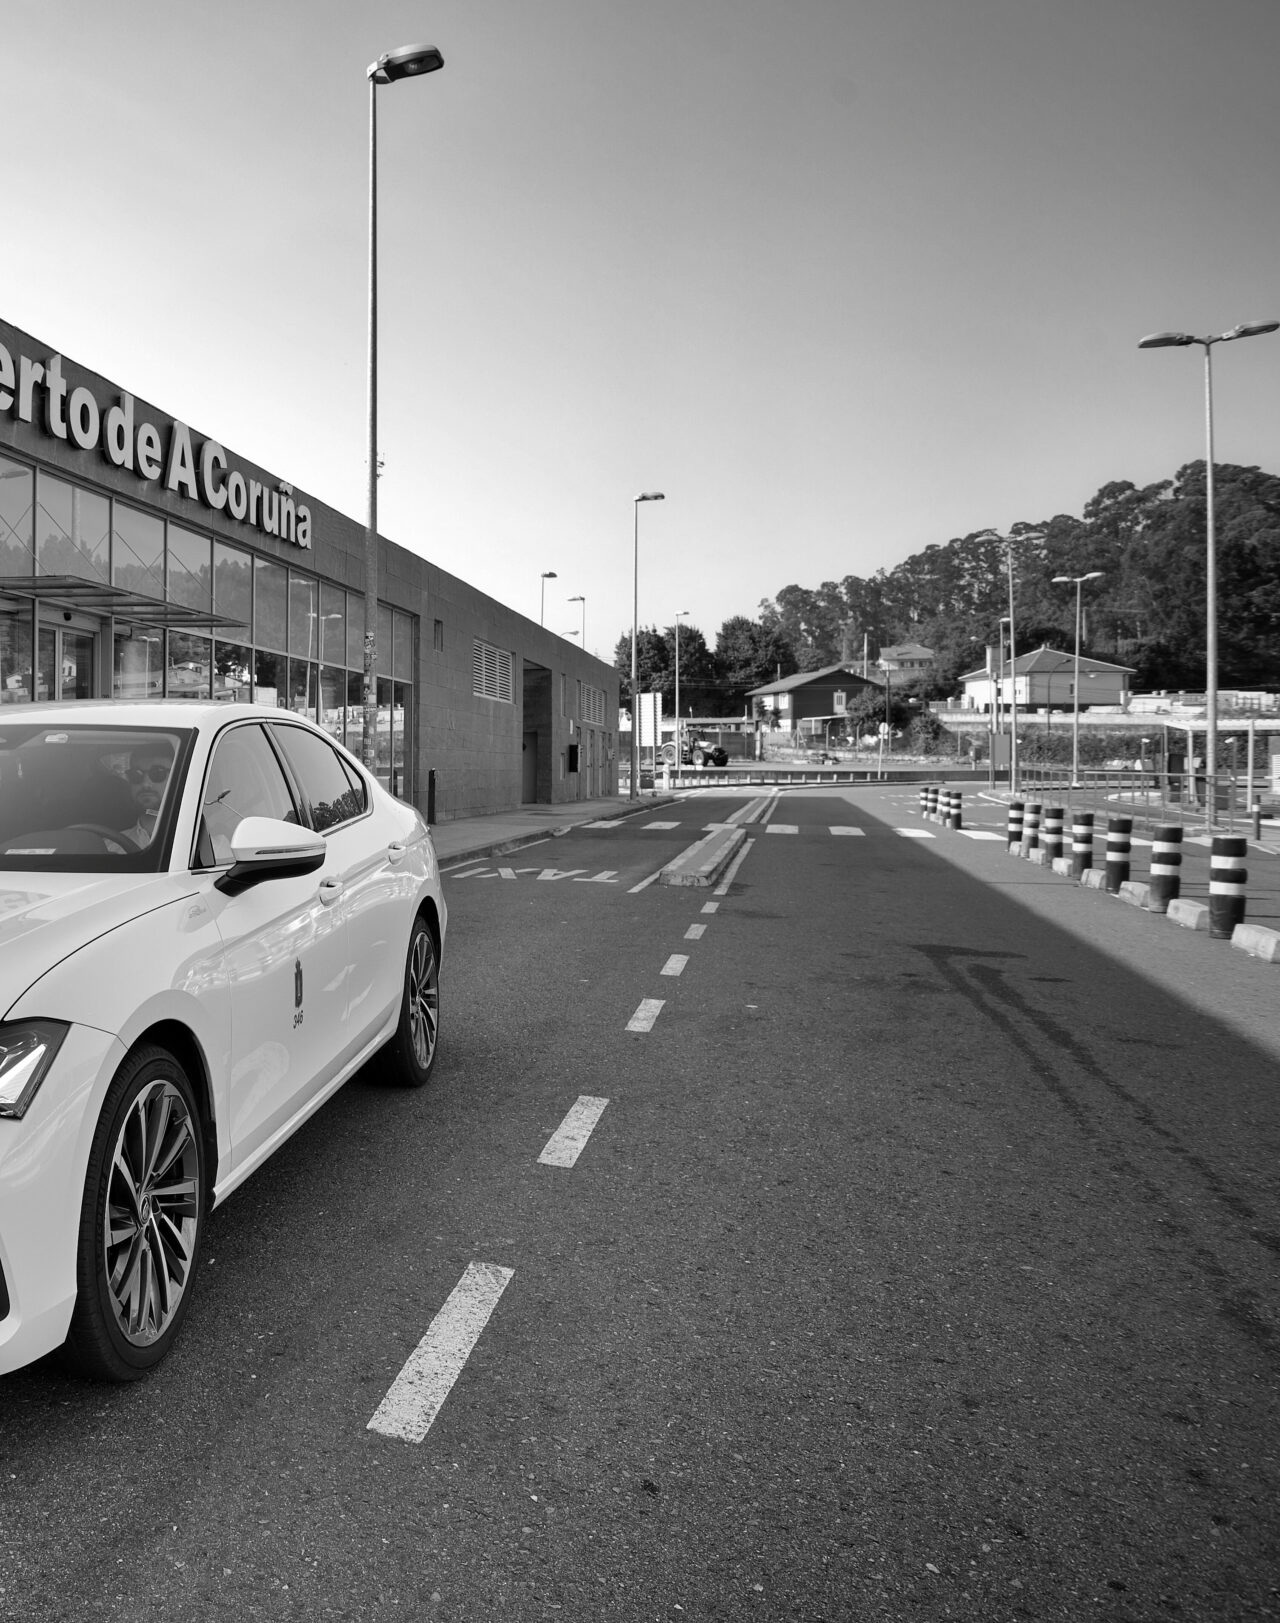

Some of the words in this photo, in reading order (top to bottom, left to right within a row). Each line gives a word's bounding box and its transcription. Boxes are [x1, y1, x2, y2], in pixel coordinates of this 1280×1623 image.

[103, 391, 162, 481] de
[164, 420, 199, 500] A
[199, 442, 313, 550] Coruña
[450, 867, 619, 883] TAXI
